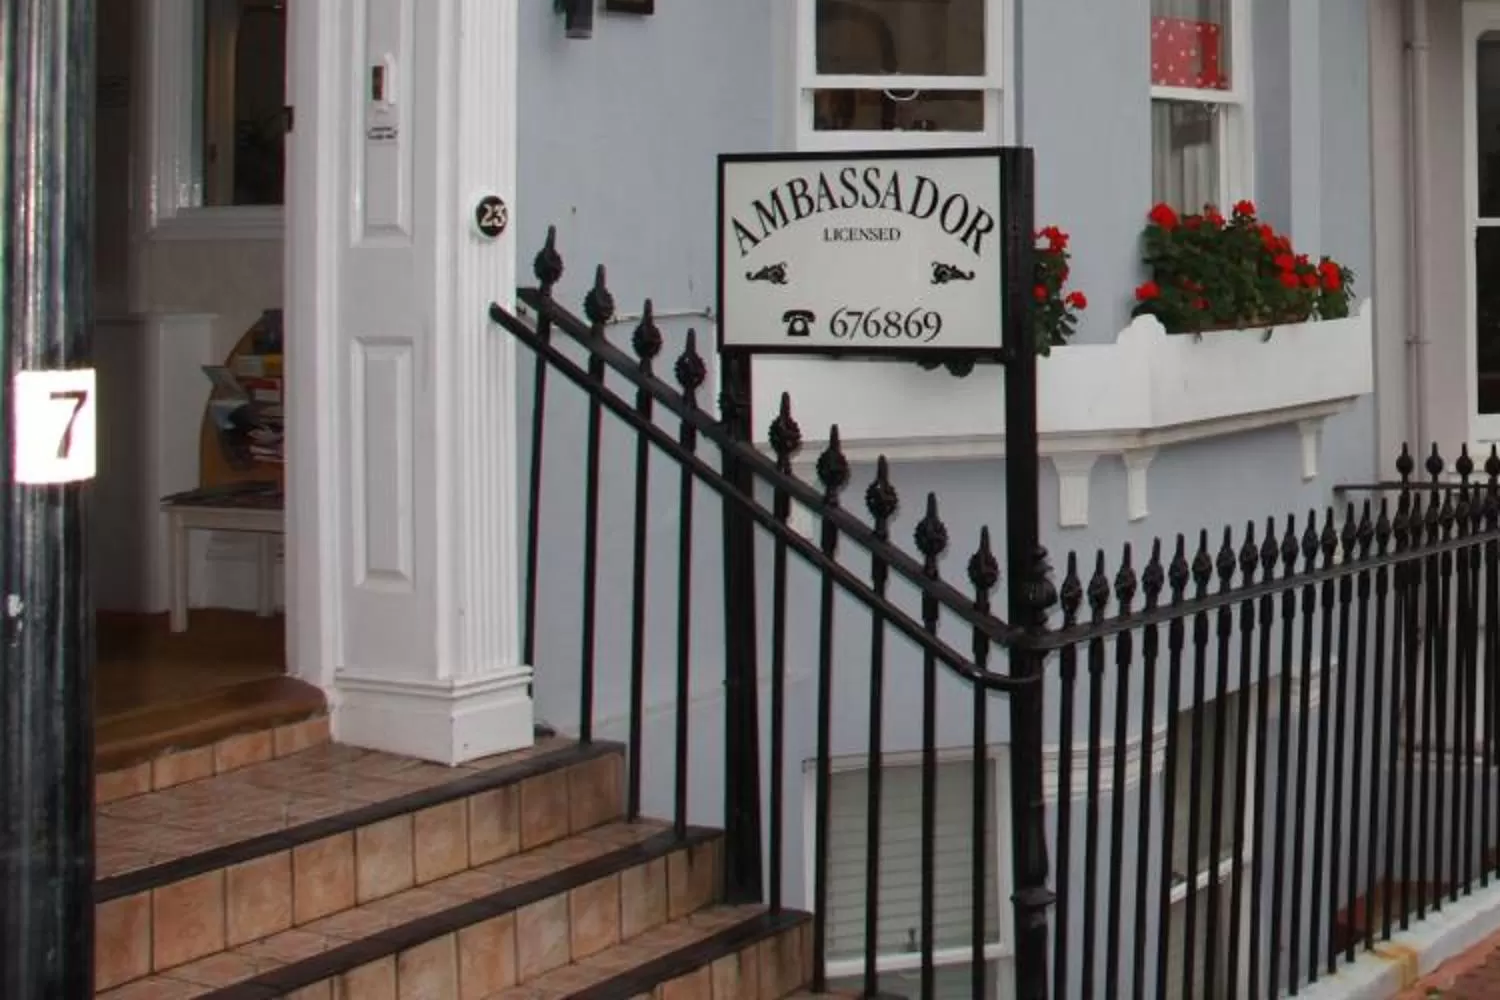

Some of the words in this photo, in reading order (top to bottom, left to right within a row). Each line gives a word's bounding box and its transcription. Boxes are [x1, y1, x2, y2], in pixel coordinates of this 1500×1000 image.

[480, 203, 507, 227] 23
[731, 167, 995, 256] AMBASSADOR
[823, 227, 901, 243] LICENSED
[829, 305, 942, 342] 676869
[49, 390, 88, 460] 7
